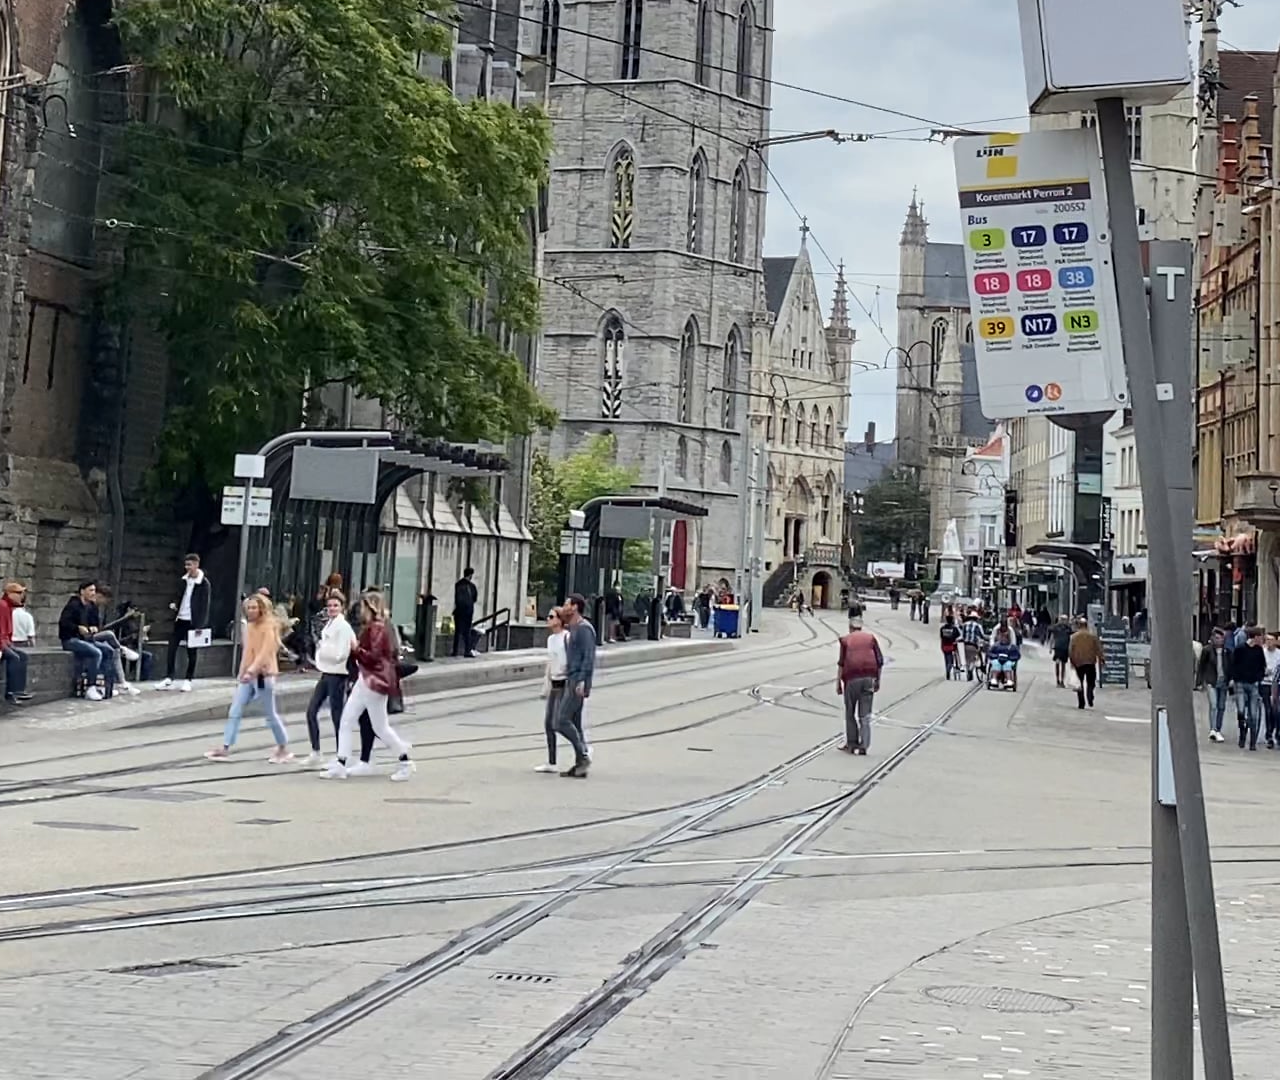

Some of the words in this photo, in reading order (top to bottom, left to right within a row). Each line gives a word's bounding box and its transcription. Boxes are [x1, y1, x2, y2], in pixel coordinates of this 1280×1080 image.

[976, 189, 1031, 203] Korenmarkt
[1065, 186, 1073, 196] 2
[968, 215, 988, 226] Bus
[982, 234, 992, 246] 3
[1020, 230, 1036, 243] 17
[1062, 227, 1078, 240] 17
[983, 277, 1000, 291] 18
[1025, 274, 1042, 288] 18
[1066, 271, 1085, 285] 38
[1157, 266, 1186, 301] T
[987, 321, 1006, 335] 39
[1024, 318, 1052, 333] N17
[1070, 315, 1091, 329] N3
